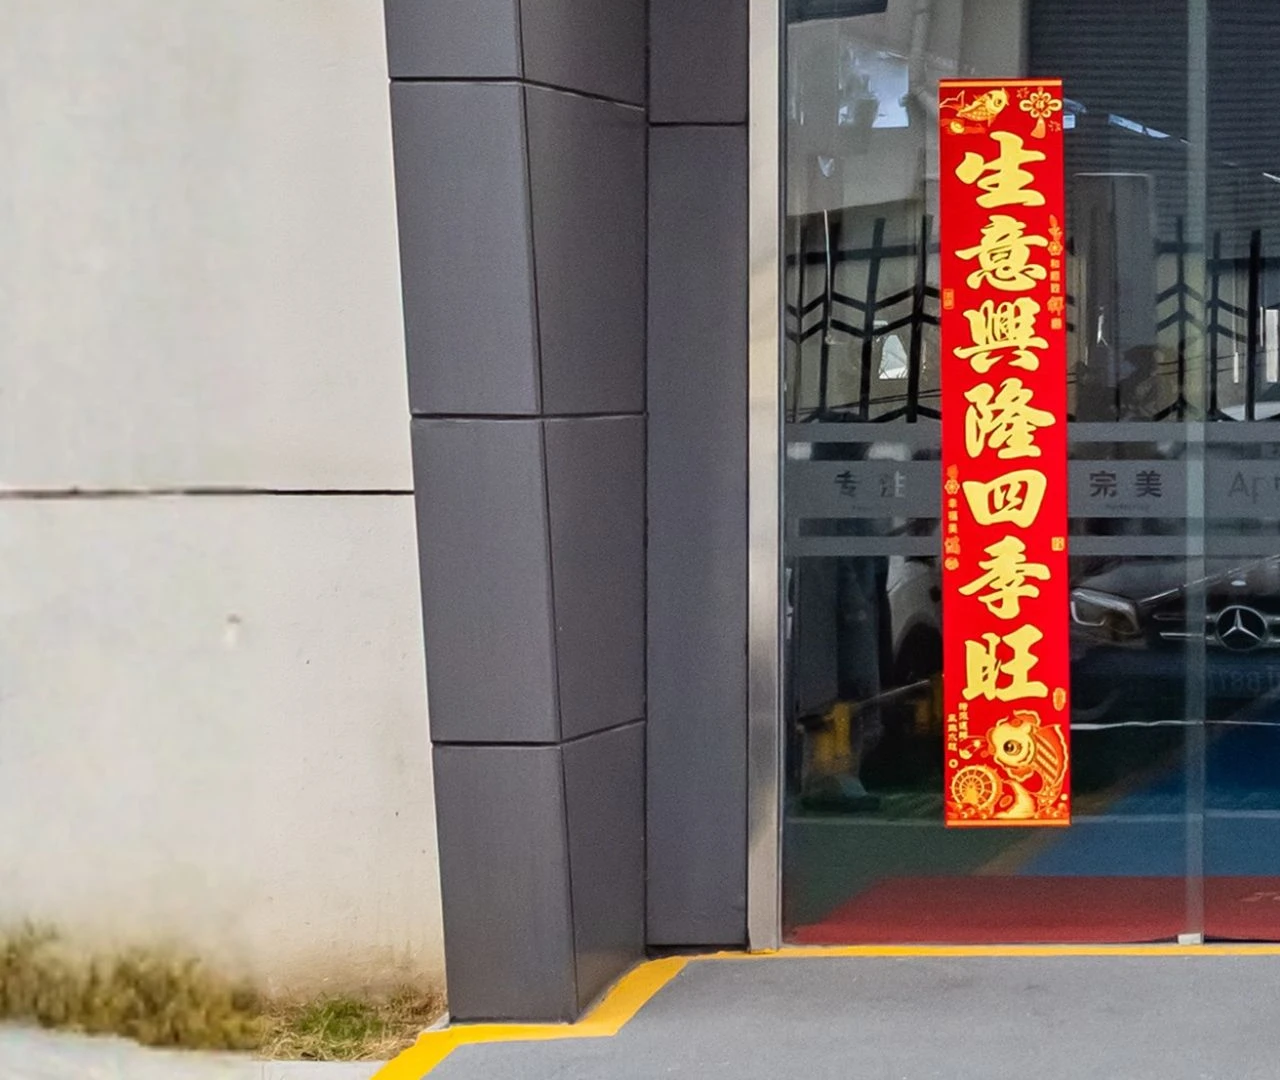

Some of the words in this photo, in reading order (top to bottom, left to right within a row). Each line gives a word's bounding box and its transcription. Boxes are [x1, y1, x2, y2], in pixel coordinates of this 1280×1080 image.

[953, 130, 1057, 703] 生意興隆四季旺
[1089, 469, 1165, 499] 完美
